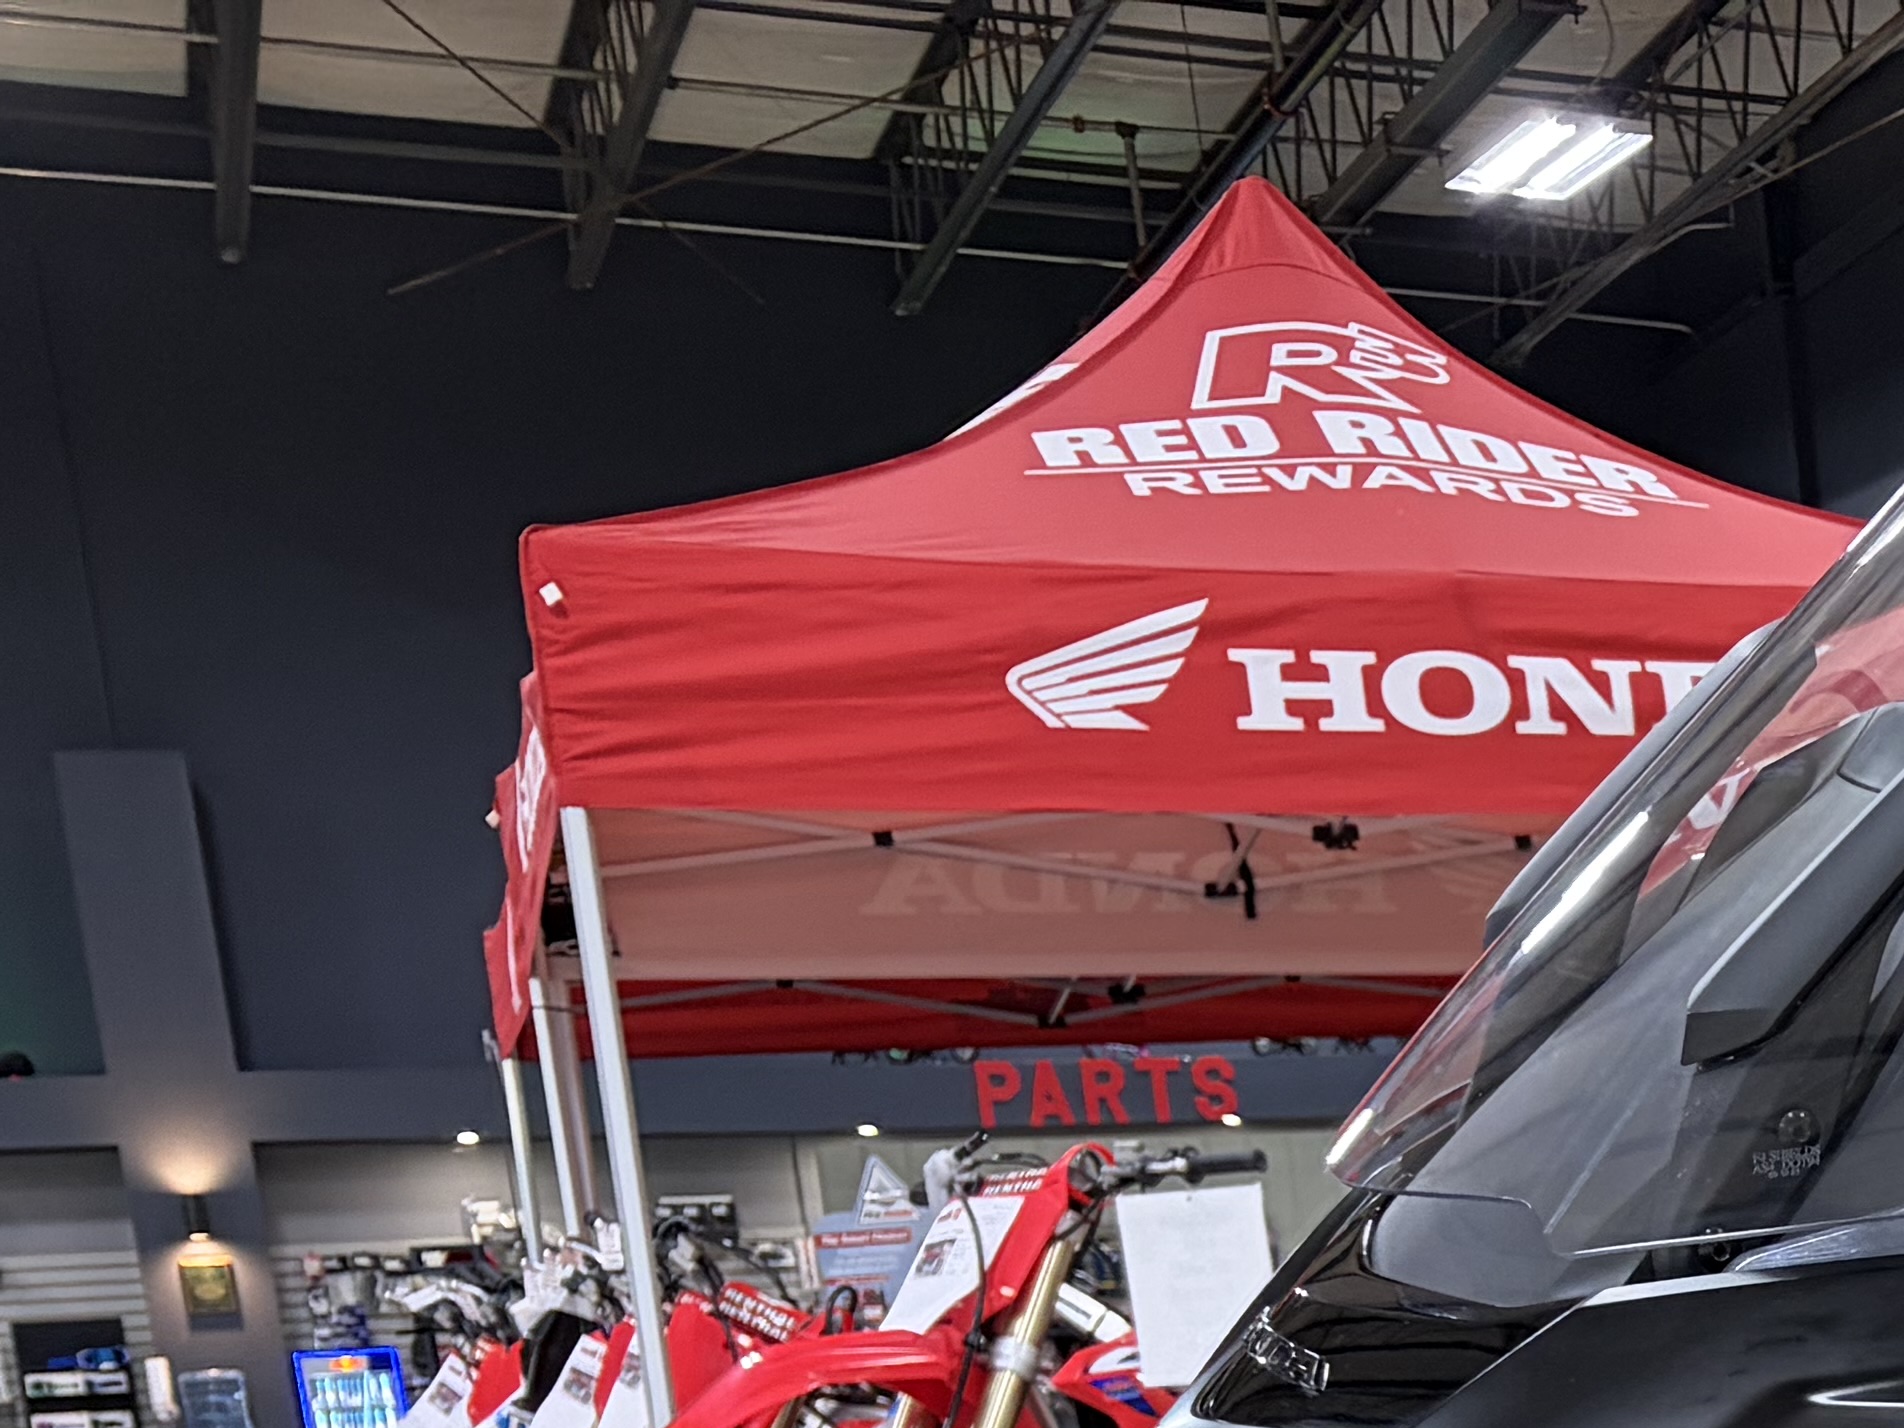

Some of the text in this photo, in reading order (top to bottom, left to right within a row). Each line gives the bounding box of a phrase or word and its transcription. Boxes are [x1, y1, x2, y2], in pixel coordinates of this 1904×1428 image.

[1031, 410, 1679, 499] RED RIDER
[1123, 464, 1641, 517] REWARDS
[1226, 646, 1718, 738] HON
[973, 1054, 1239, 1129] PARTS
